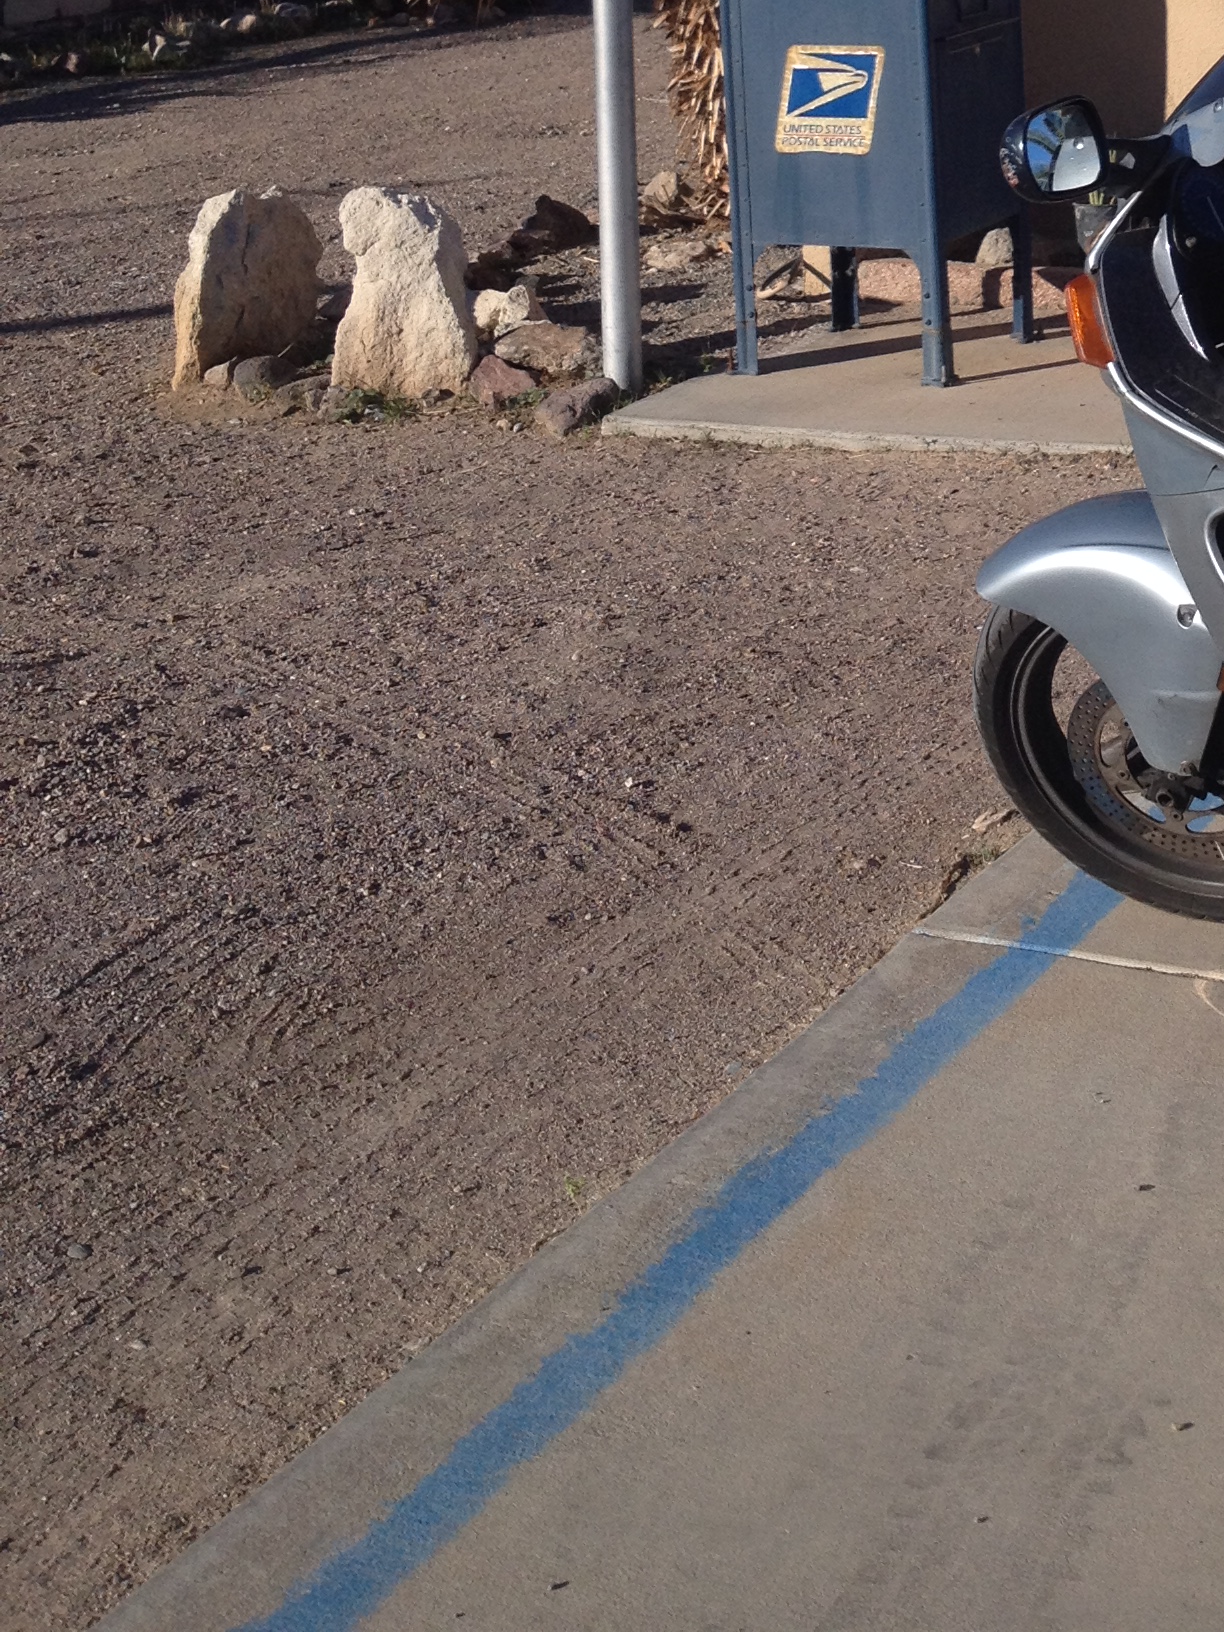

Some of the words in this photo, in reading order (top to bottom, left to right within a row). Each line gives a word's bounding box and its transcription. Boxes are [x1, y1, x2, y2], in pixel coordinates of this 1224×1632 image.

[783, 124, 824, 134] UNITED
[825, 125, 862, 135] STATES
[781, 136, 820, 147] POSTAL
[822, 137, 866, 148] SERVICE
